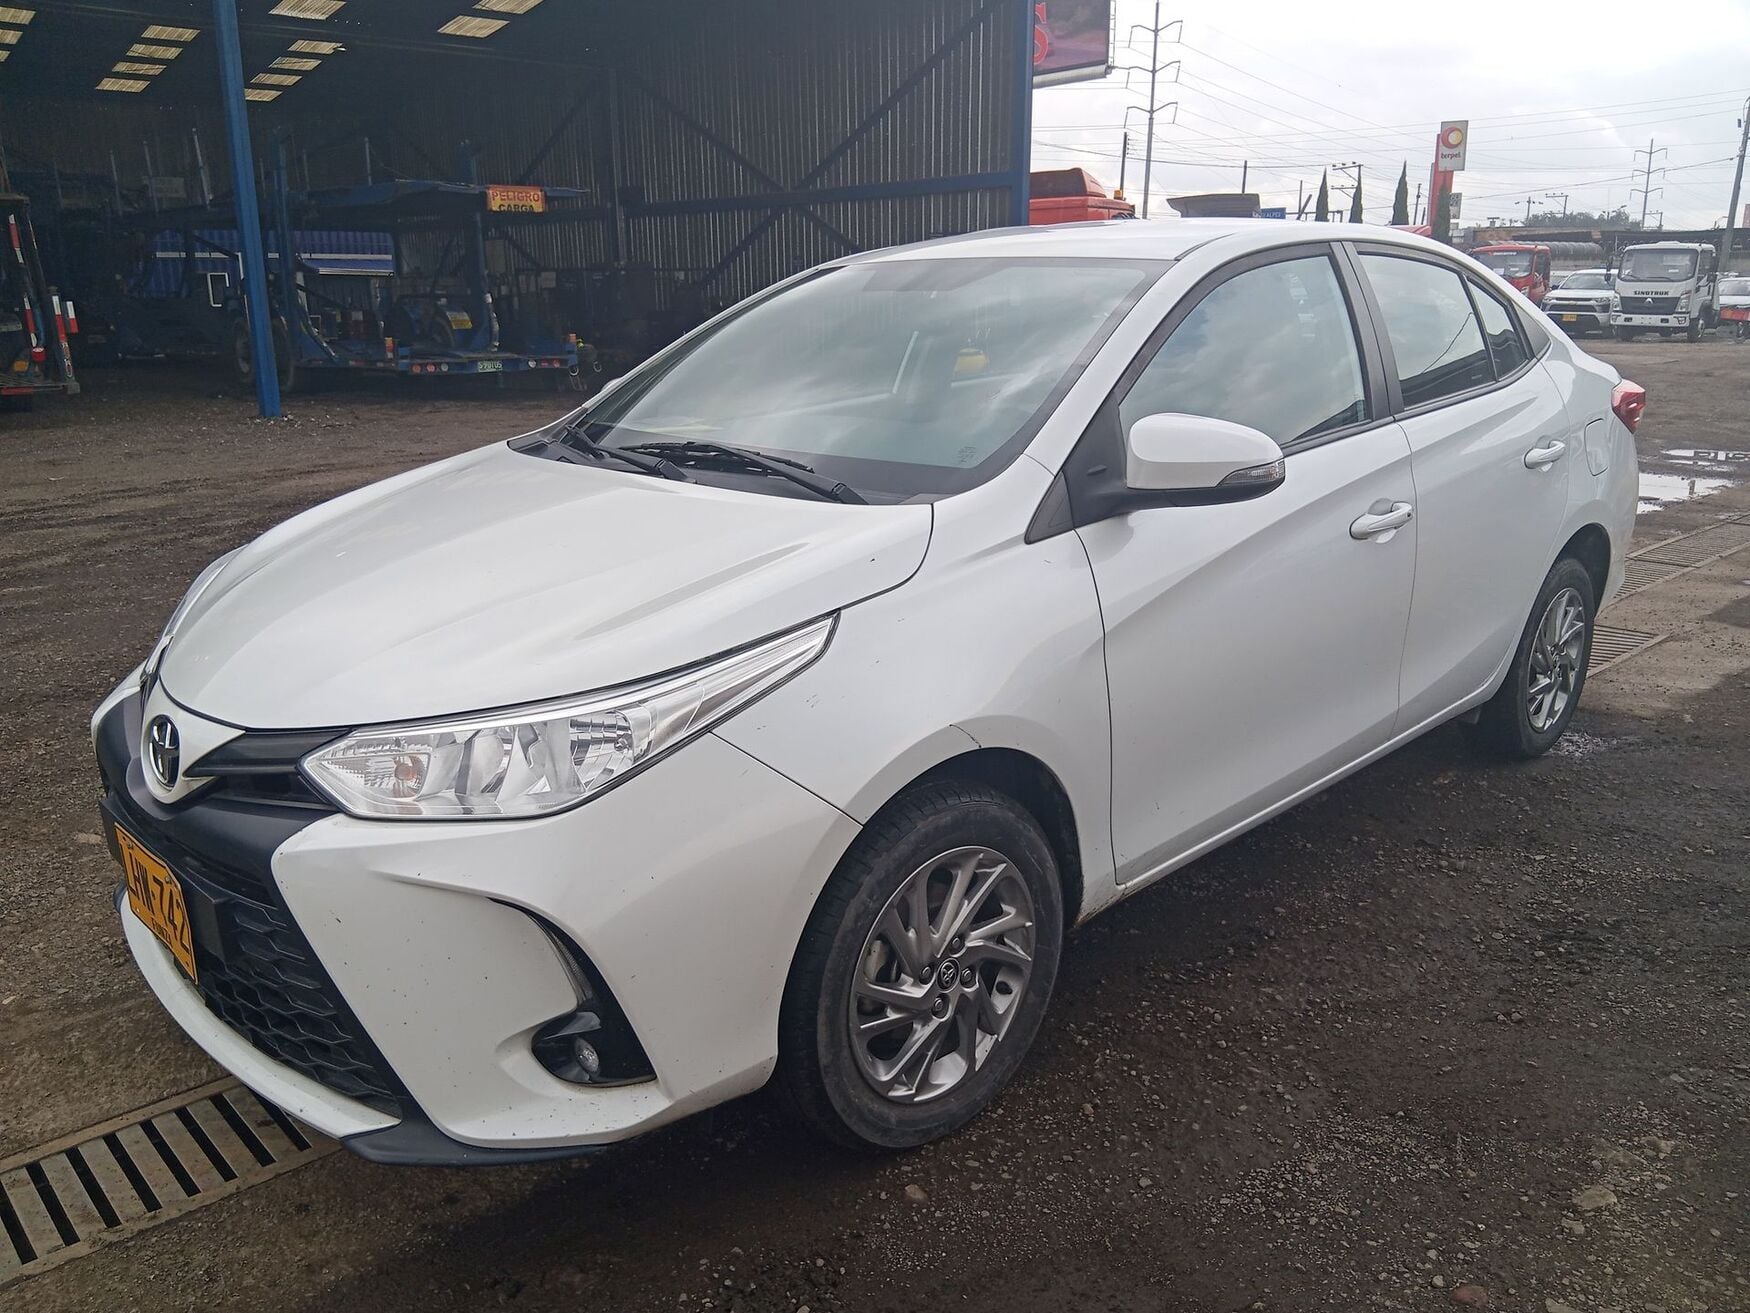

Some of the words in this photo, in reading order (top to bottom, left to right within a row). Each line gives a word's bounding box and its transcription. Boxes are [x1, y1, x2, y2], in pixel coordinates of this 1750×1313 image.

[1440, 152, 1461, 160] terpel
[491, 190, 540, 202] PELIGRO
[498, 204, 535, 212] CARGA
